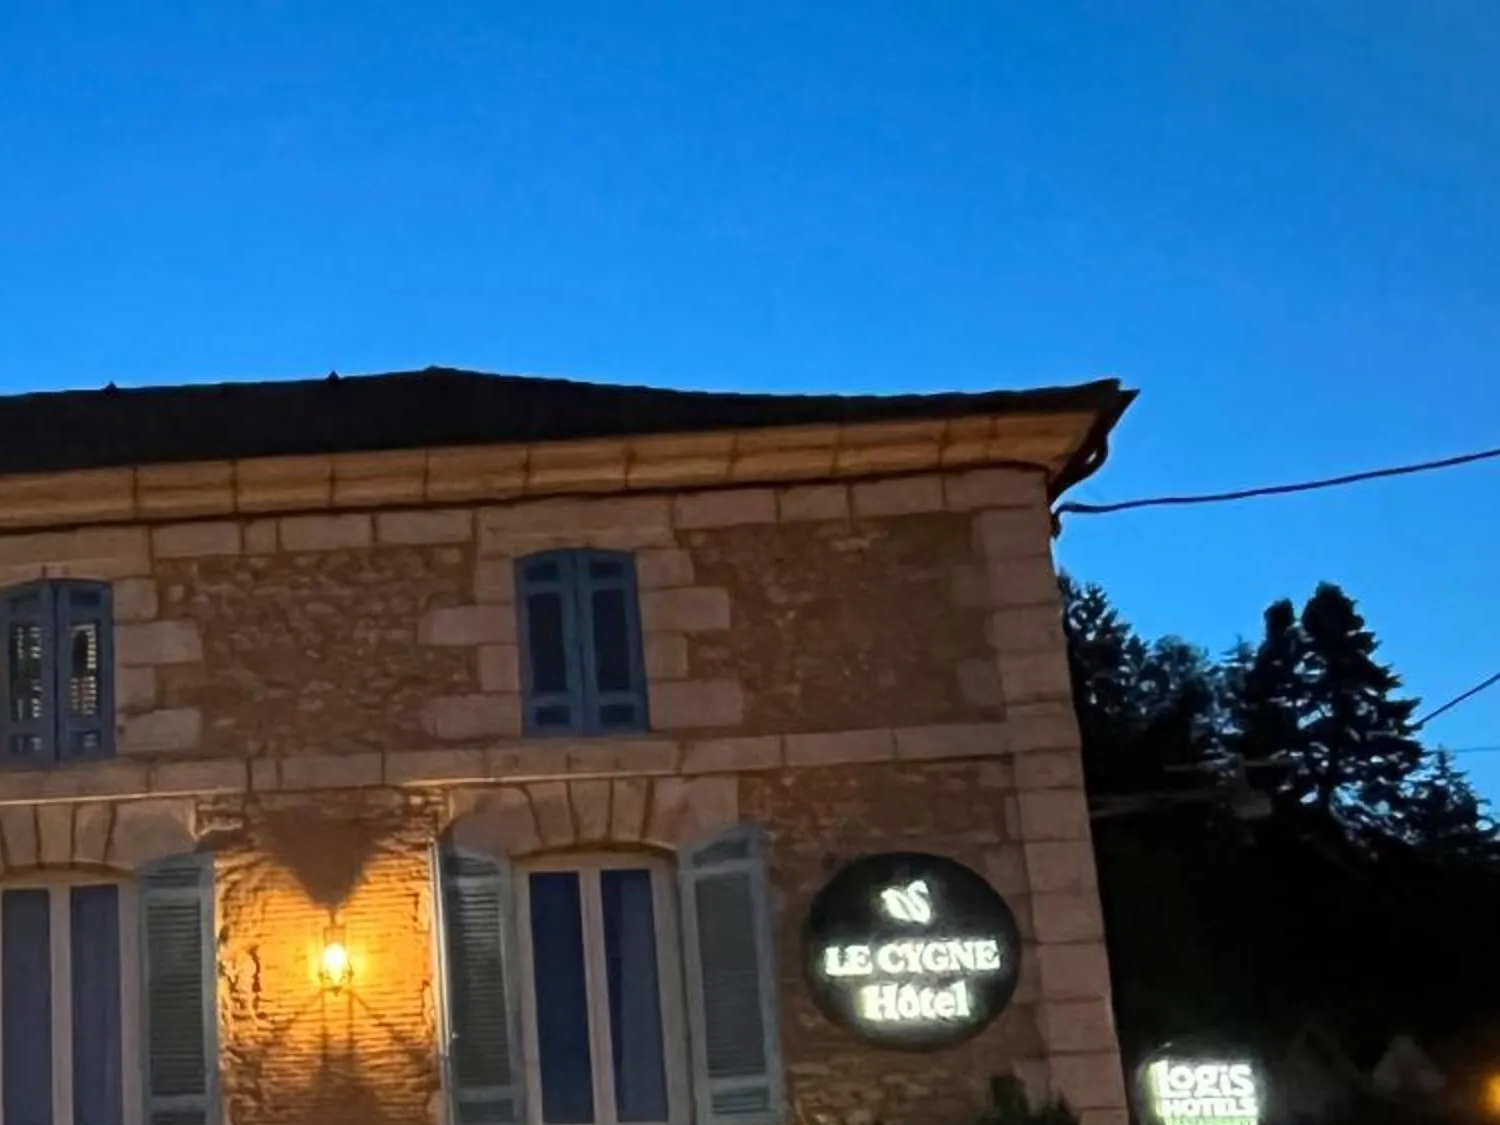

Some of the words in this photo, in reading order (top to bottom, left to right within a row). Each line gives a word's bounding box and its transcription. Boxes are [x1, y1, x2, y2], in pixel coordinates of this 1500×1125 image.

[825, 945, 873, 976] LE
[878, 939, 1001, 974] CYGNE
[862, 981, 970, 1020] Hôtel
